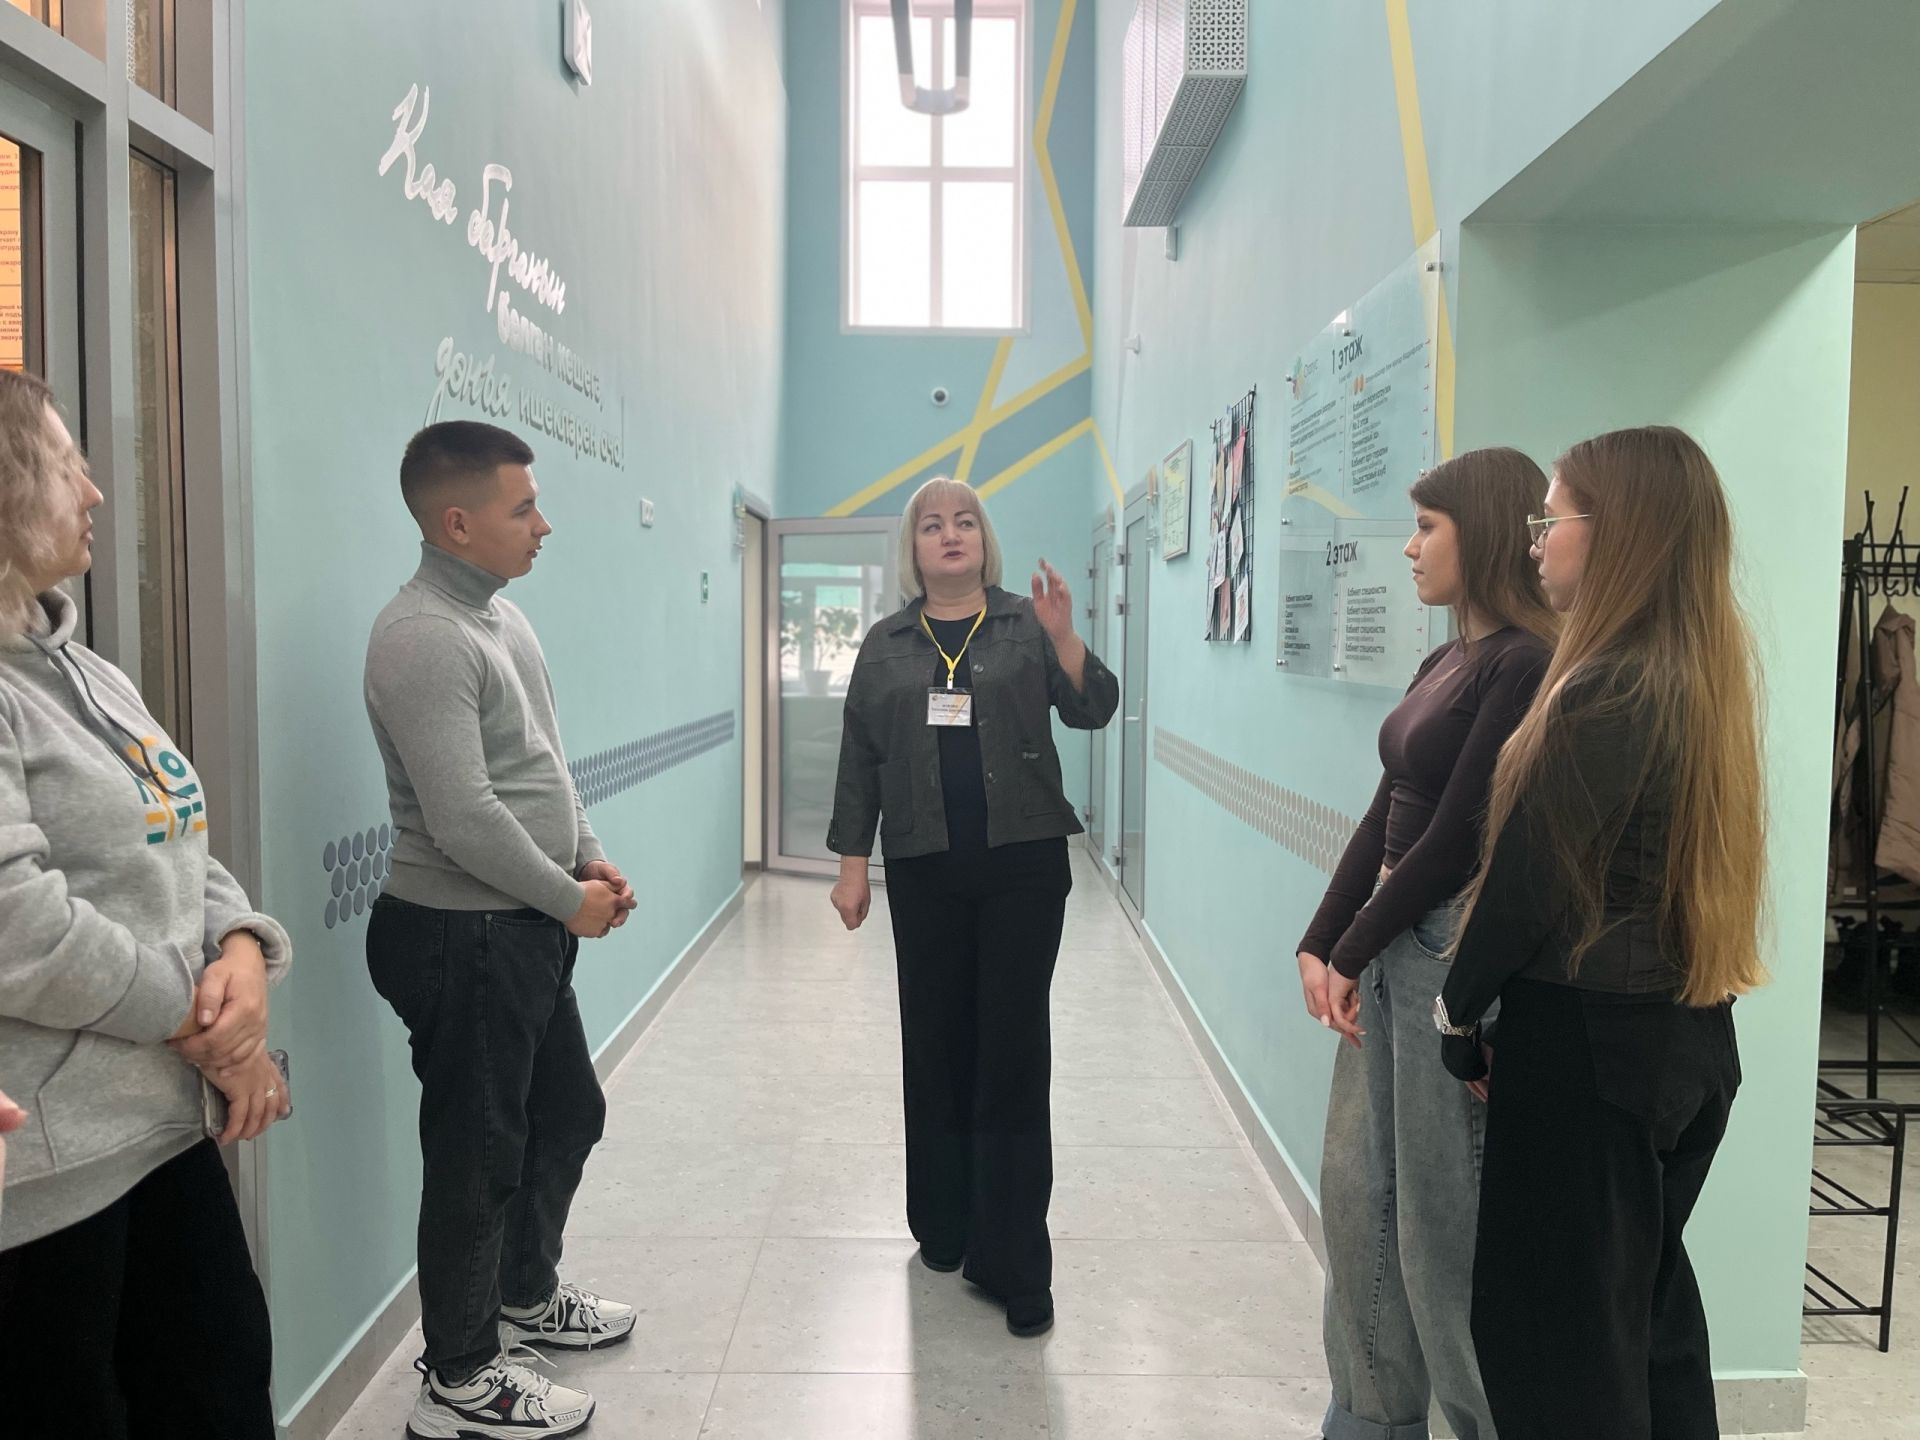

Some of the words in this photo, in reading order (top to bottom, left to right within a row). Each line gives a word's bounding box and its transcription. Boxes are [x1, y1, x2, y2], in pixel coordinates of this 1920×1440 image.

[378, 82, 458, 225] Кая
[1338, 335, 1363, 371] этаж
[1326, 541, 1332, 566] 2
[1333, 540, 1359, 565] этаж
